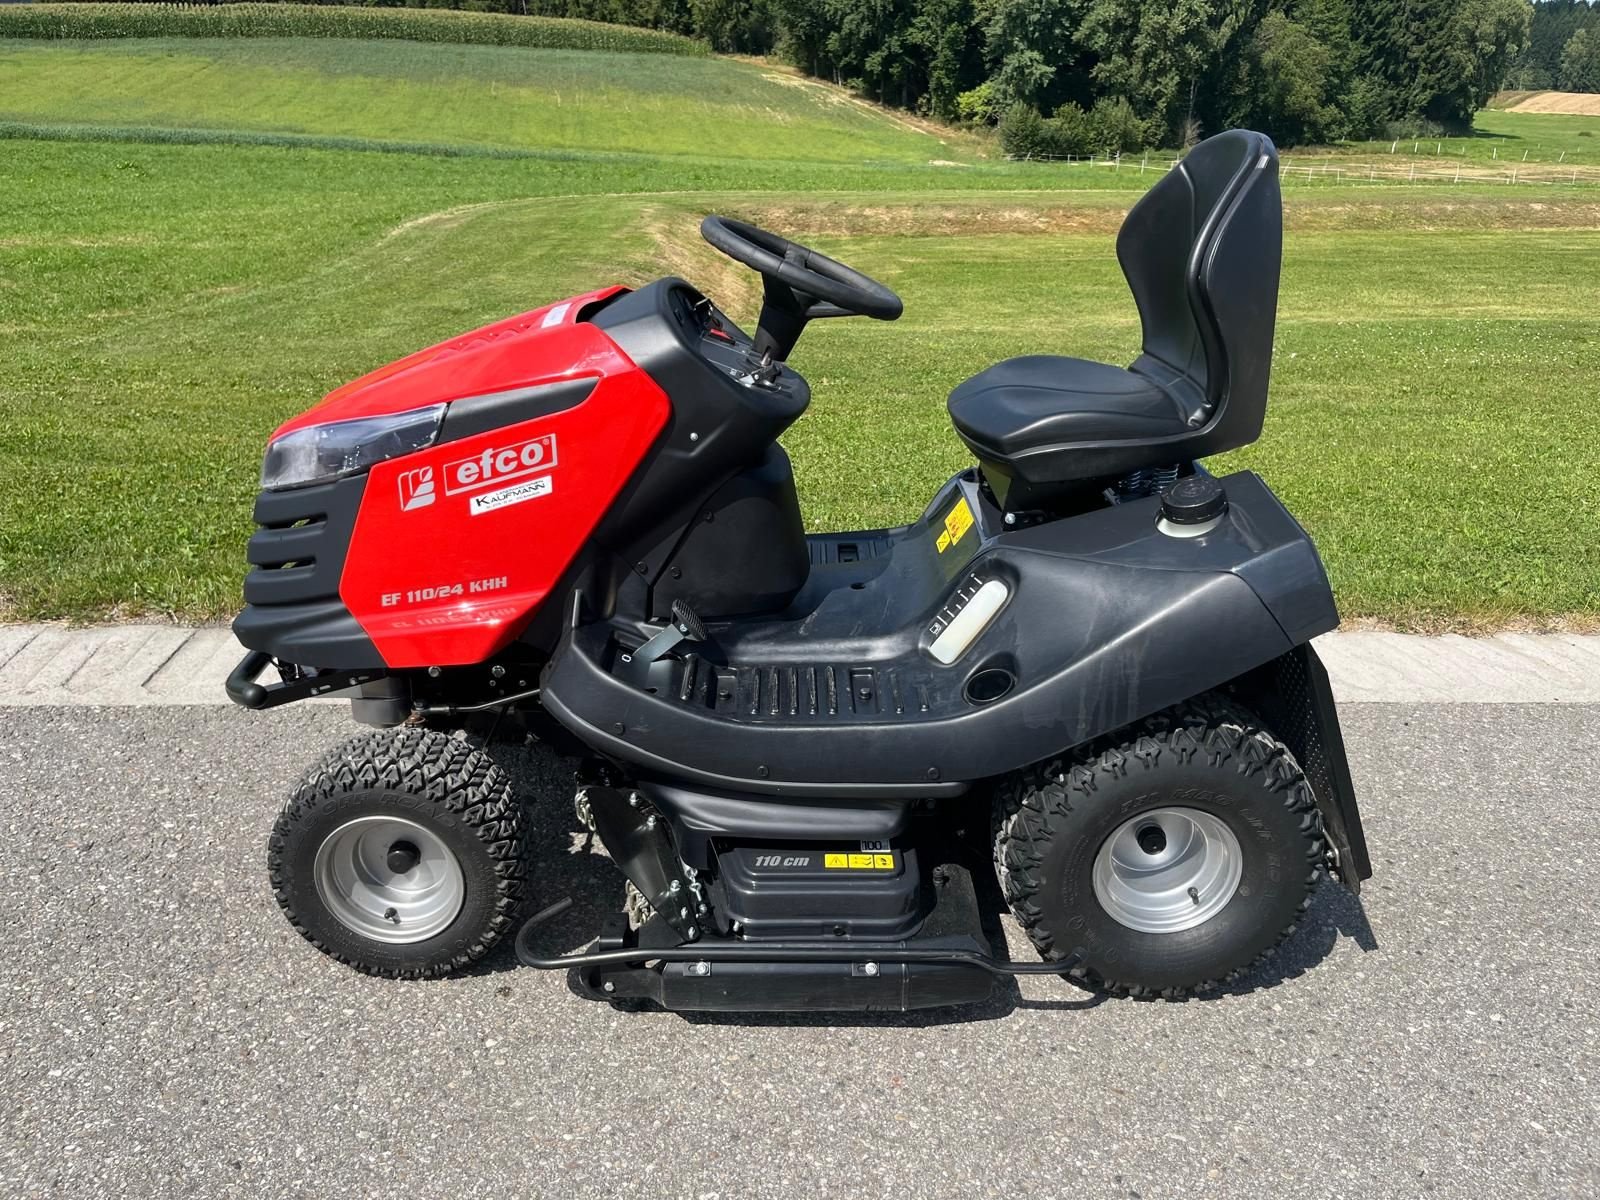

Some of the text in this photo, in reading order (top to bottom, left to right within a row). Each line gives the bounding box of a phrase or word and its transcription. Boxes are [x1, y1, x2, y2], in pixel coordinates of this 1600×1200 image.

[382, 576, 507, 607] EF 110/24 KHH
[755, 855, 810, 867] 110 cm
